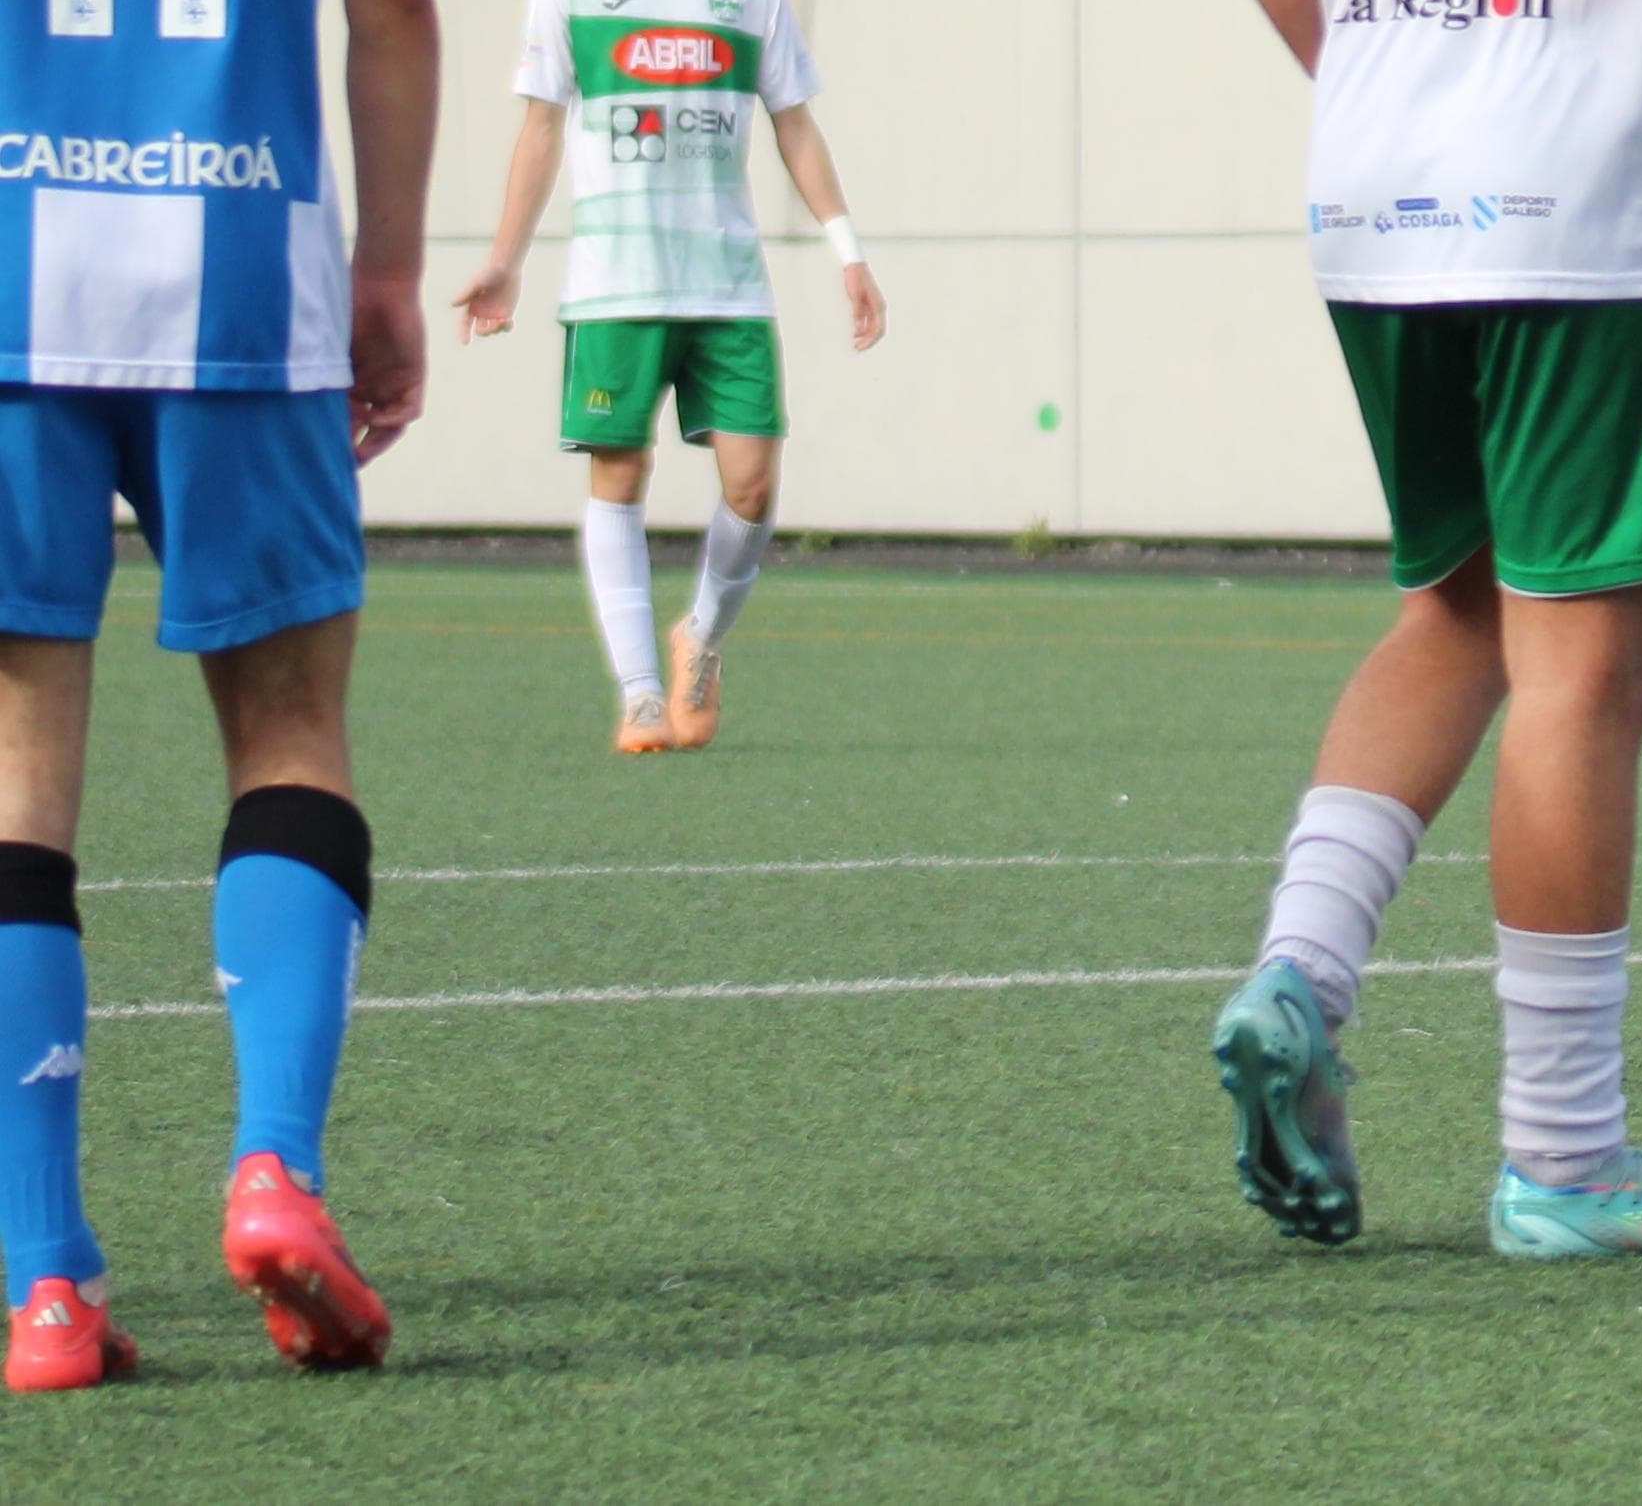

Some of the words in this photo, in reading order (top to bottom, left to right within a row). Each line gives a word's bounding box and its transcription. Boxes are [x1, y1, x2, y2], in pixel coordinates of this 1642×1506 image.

[628, 36, 722, 72] ABRIL
[676, 108, 736, 136] CEN
[0, 131, 283, 190] CABREIROÁ
[1399, 213, 1464, 229] COSAGA
